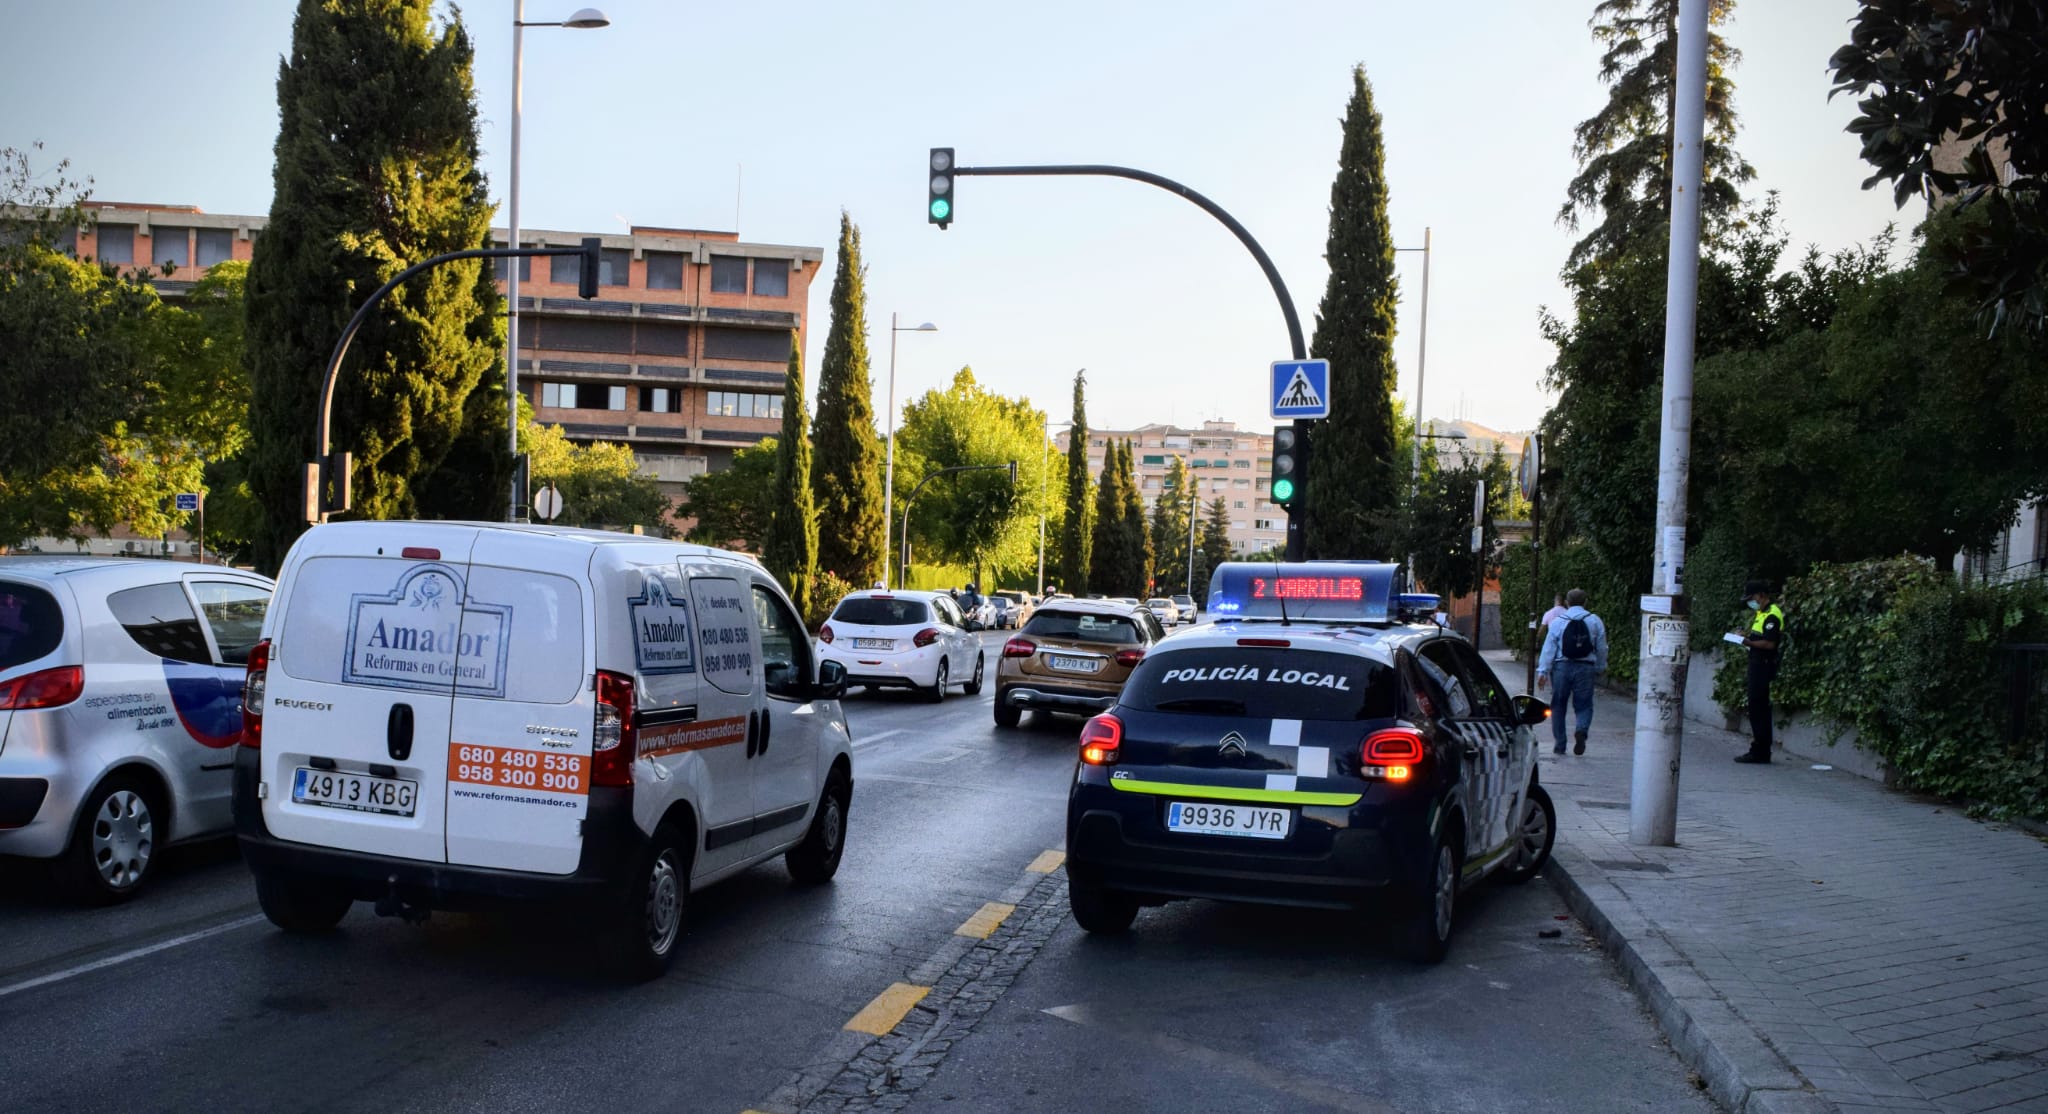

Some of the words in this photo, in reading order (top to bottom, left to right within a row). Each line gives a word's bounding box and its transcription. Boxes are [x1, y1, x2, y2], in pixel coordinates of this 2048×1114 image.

[1253, 578, 1265, 598] 2
[1274, 577, 1362, 599] CARRILES
[367, 617, 489, 658] Amador
[643, 615, 685, 643] Amador
[703, 628, 717, 645] 680
[720, 627, 733, 644] 480
[734, 627, 749, 643] 536
[364, 653, 418, 674] Reformas
[421, 661, 434, 675] en
[439, 660, 486, 680] General
[705, 655, 720, 672] 958
[722, 653, 736, 670] 300
[737, 652, 750, 669] 900
[1056, 657, 1077, 668] 2370
[1162, 664, 1259, 684] POLICÍA
[1266, 669, 1350, 691] LOCAL
[85, 693, 143, 708] especialistas
[144, 692, 156, 702] en
[274, 698, 334, 712] PEUGEOT
[107, 703, 167, 720] alimentación
[136, 718, 159, 731] Desde
[640, 722, 744, 752] www.reformasamador.es
[460, 746, 495, 764] 680
[501, 750, 537, 768] 480
[543, 754, 580, 772] 536
[458, 764, 494, 782] 958
[500, 768, 536, 786] 300
[542, 772, 579, 790] 900
[1113, 770, 1129, 779] GC
[309, 775, 361, 801] 4913
[368, 782, 411, 807] KBG
[454, 788, 578, 808] www.reformasamador.es
[1183, 807, 1235, 827] 9936
[1243, 811, 1283, 831] JYR
